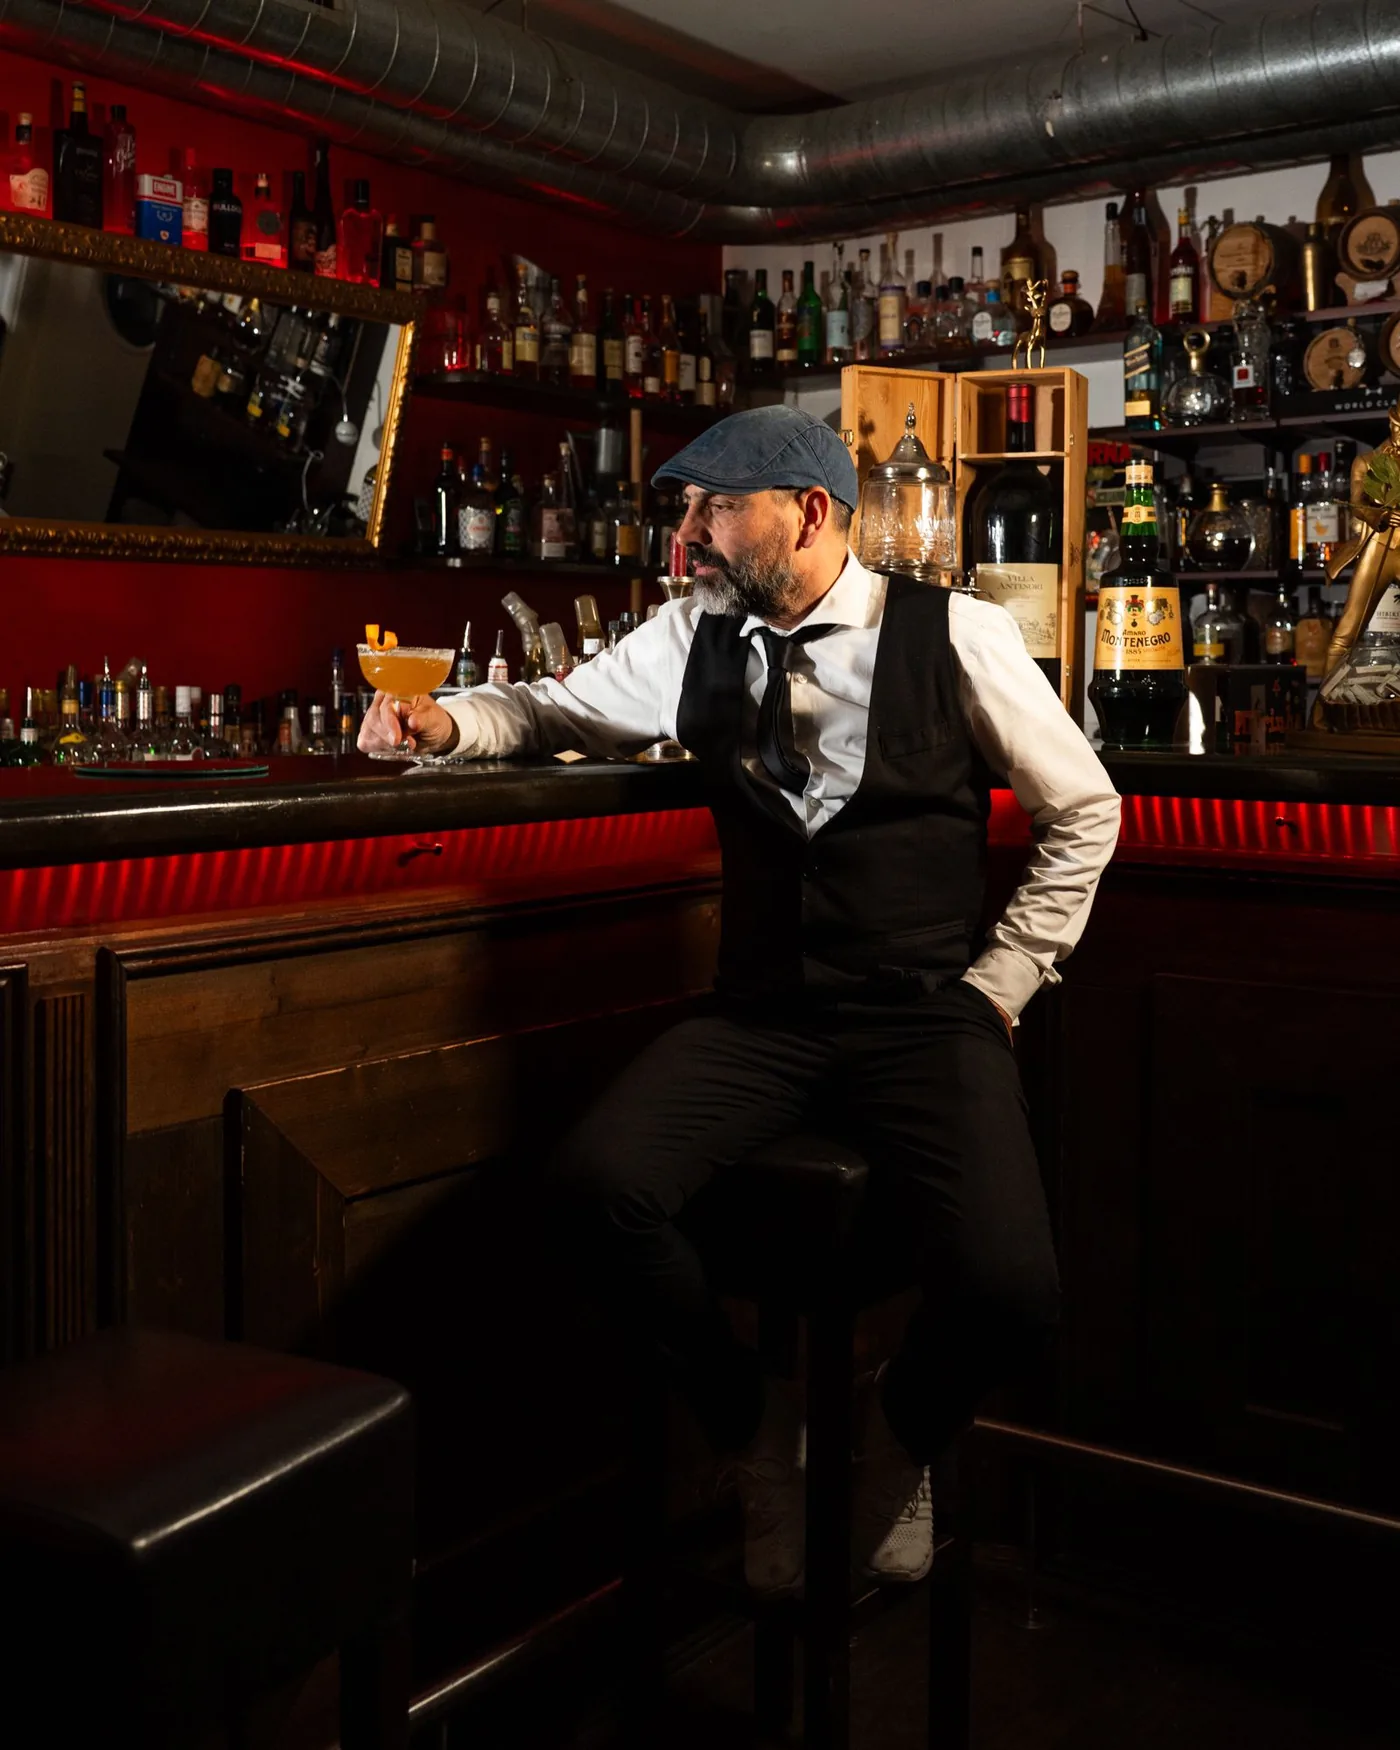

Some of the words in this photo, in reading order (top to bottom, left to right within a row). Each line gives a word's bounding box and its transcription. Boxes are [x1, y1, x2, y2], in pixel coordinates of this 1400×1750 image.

[1334, 401, 1373, 411] WORLD
[1007, 574, 1036, 582] VILLA
[998, 582, 1043, 590] ANTINORI
[1101, 628, 1171, 648] MONTENEGRO
